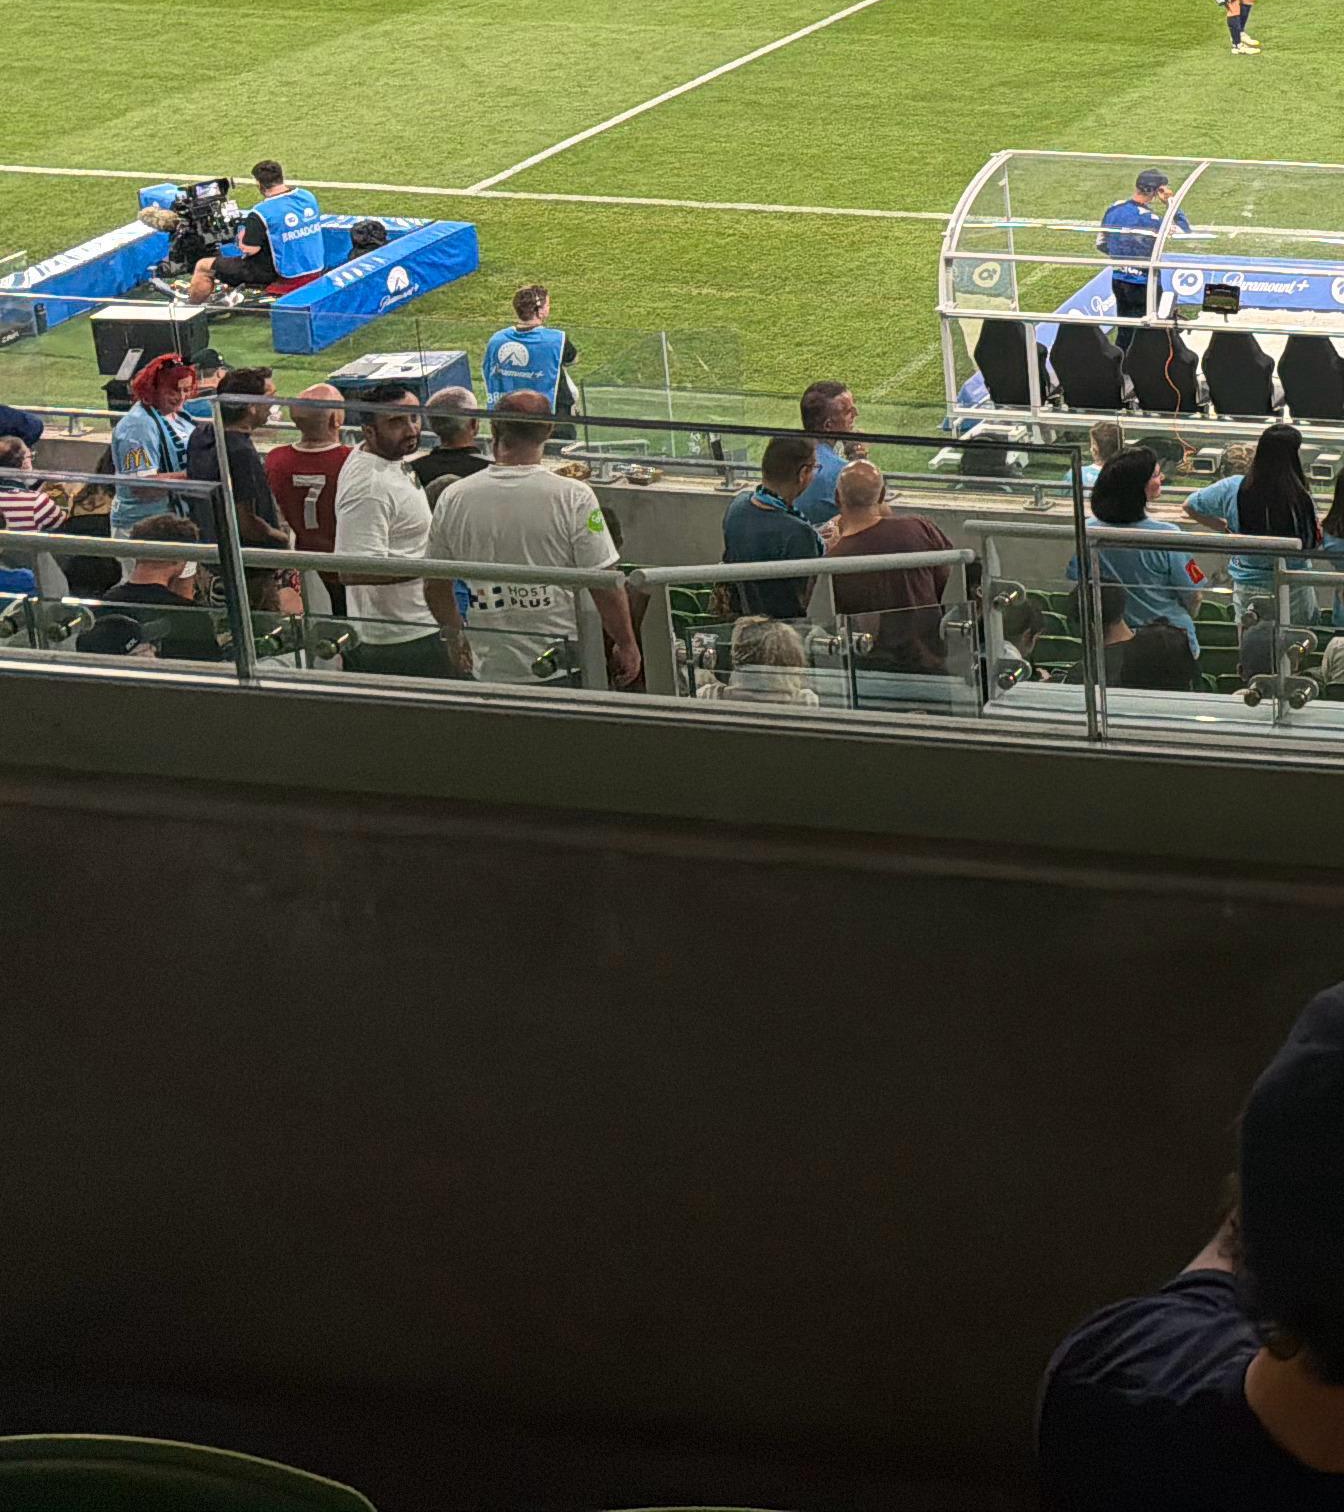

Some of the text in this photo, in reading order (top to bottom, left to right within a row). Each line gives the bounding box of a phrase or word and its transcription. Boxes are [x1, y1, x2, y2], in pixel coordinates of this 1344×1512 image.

[292, 474, 326, 530] 7
[508, 585, 548, 598] HOST
[510, 597, 551, 609] PLUS
